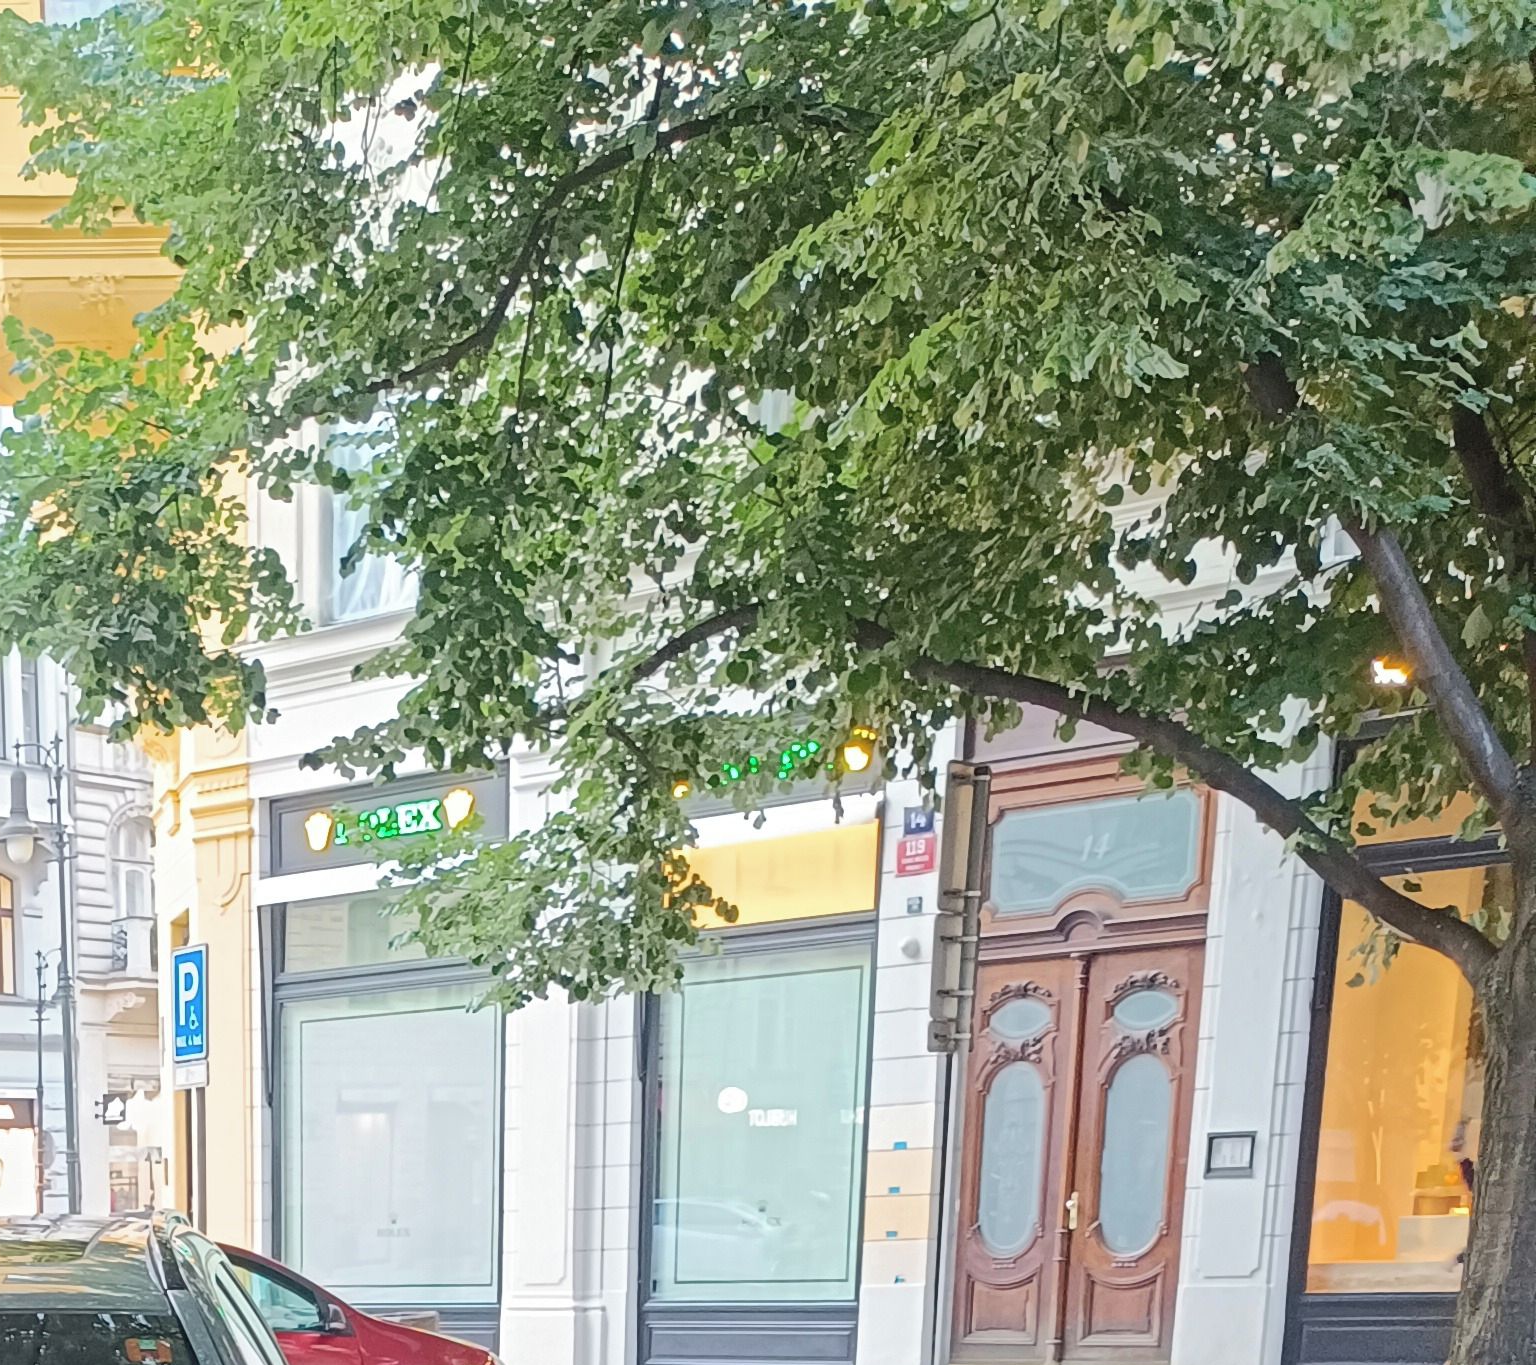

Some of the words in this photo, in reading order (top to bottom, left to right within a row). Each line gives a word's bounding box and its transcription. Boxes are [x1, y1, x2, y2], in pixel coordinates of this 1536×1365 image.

[910, 811, 927, 829] 14
[905, 839, 926, 857] 119
[1081, 832, 1111, 861] 14
[178, 961, 200, 1026] P
